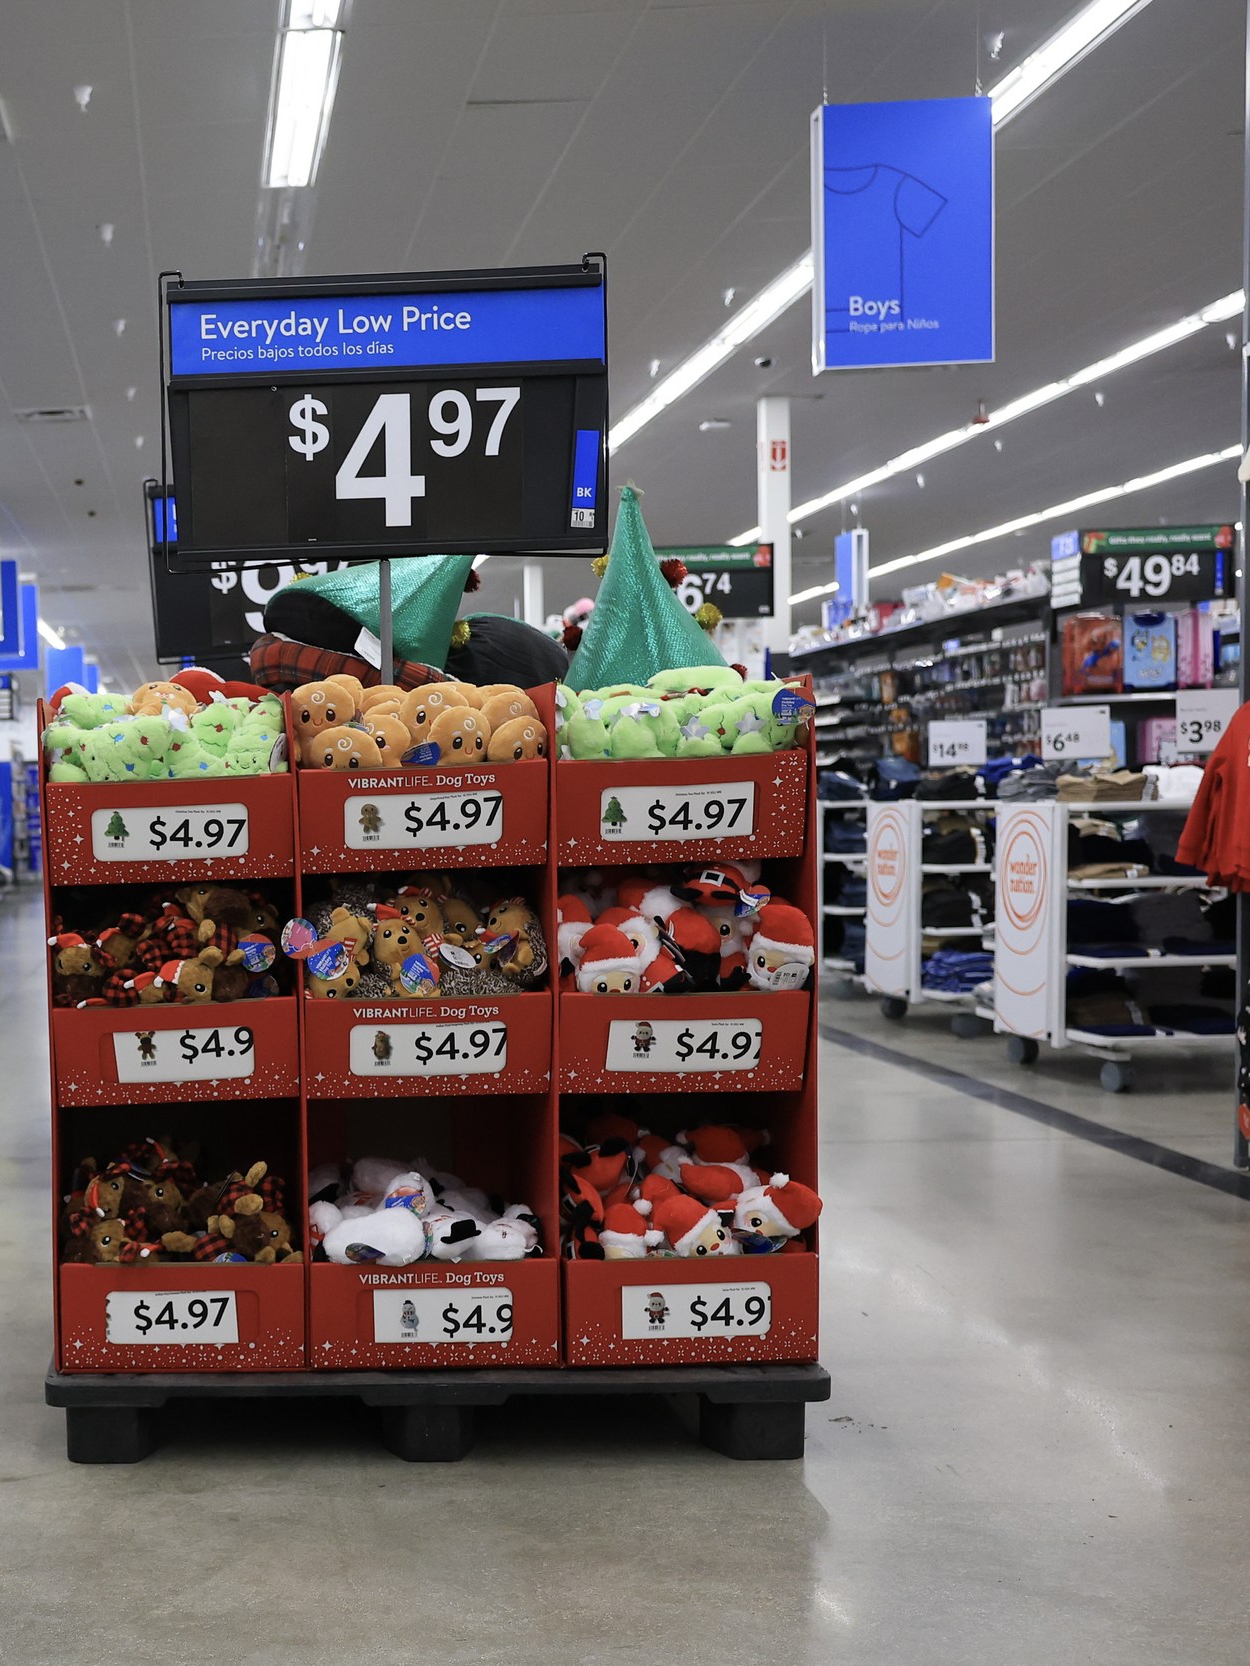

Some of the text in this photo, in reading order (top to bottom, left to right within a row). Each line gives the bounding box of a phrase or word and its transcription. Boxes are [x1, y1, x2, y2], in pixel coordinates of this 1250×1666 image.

[849, 295, 901, 321] Boys
[200, 305, 472, 343] Everyday Low Price
[849, 318, 940, 334] Ropa para Niños
[201, 341, 394, 361] Precios bajos todos los días
[576, 487, 592, 498] BK
[574, 510, 585, 521] 10
[347, 773, 496, 789] VIBRANTLIFE Dog Toys
[404, 795, 503, 838] $4.97
[647, 798, 748, 836] $4.97
[149, 815, 247, 851] $4.97
[1010, 855, 1038, 876] wonder
[353, 1005, 499, 1018] VIBRANTLIFE Dog Toys
[179, 1026, 254, 1064] $4.9
[414, 1027, 507, 1066] $4.97
[359, 1271, 504, 1286] VIBRANTLIFE Dog Toys
[133, 1297, 229, 1336] $4.97
[442, 1302, 513, 1339] $4.9
[690, 1295, 771, 1332] $4.9
